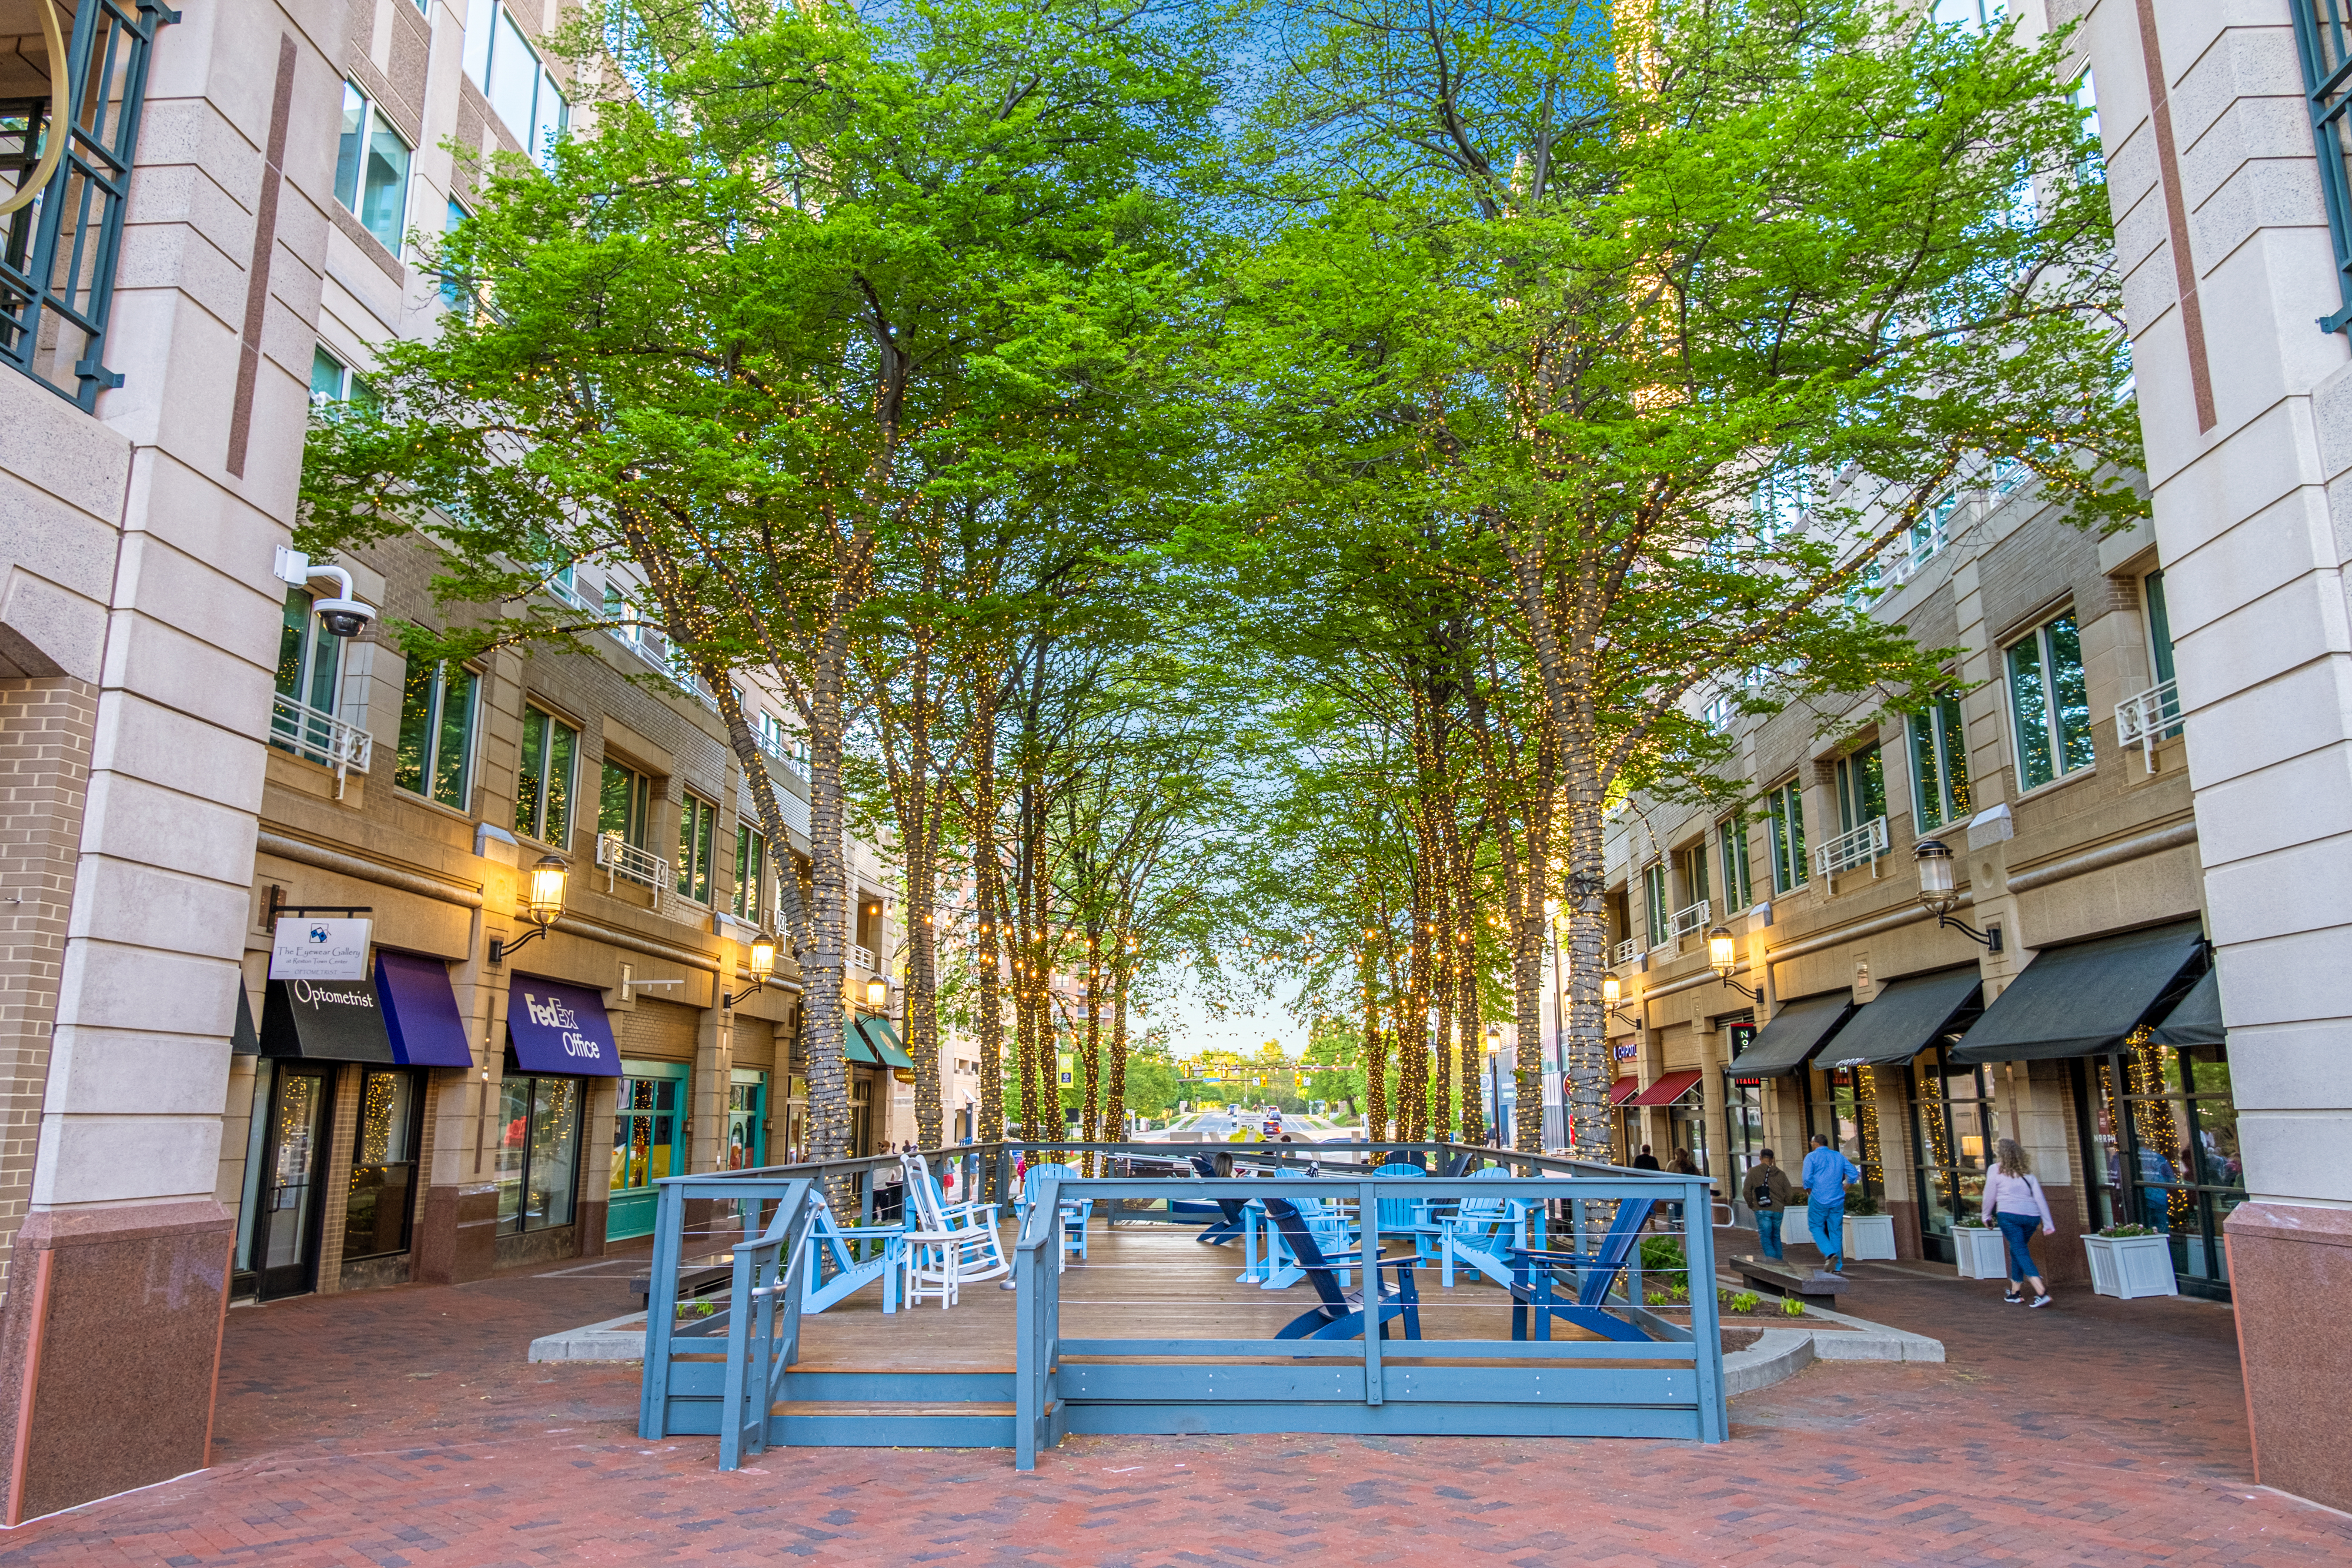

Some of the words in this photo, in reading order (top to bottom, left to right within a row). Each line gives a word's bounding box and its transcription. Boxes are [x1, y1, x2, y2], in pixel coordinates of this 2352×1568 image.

[278, 947, 293, 956] The
[296, 947, 330, 957] Eyewear
[332, 947, 360, 958] Gallery
[295, 979, 373, 1009] Optometrist
[524, 993, 579, 1029] FedEx
[563, 1031, 600, 1058] Office
[1618, 1044, 1637, 1058] CHIPOTL
[2094, 1134, 2116, 1143] NORTH
